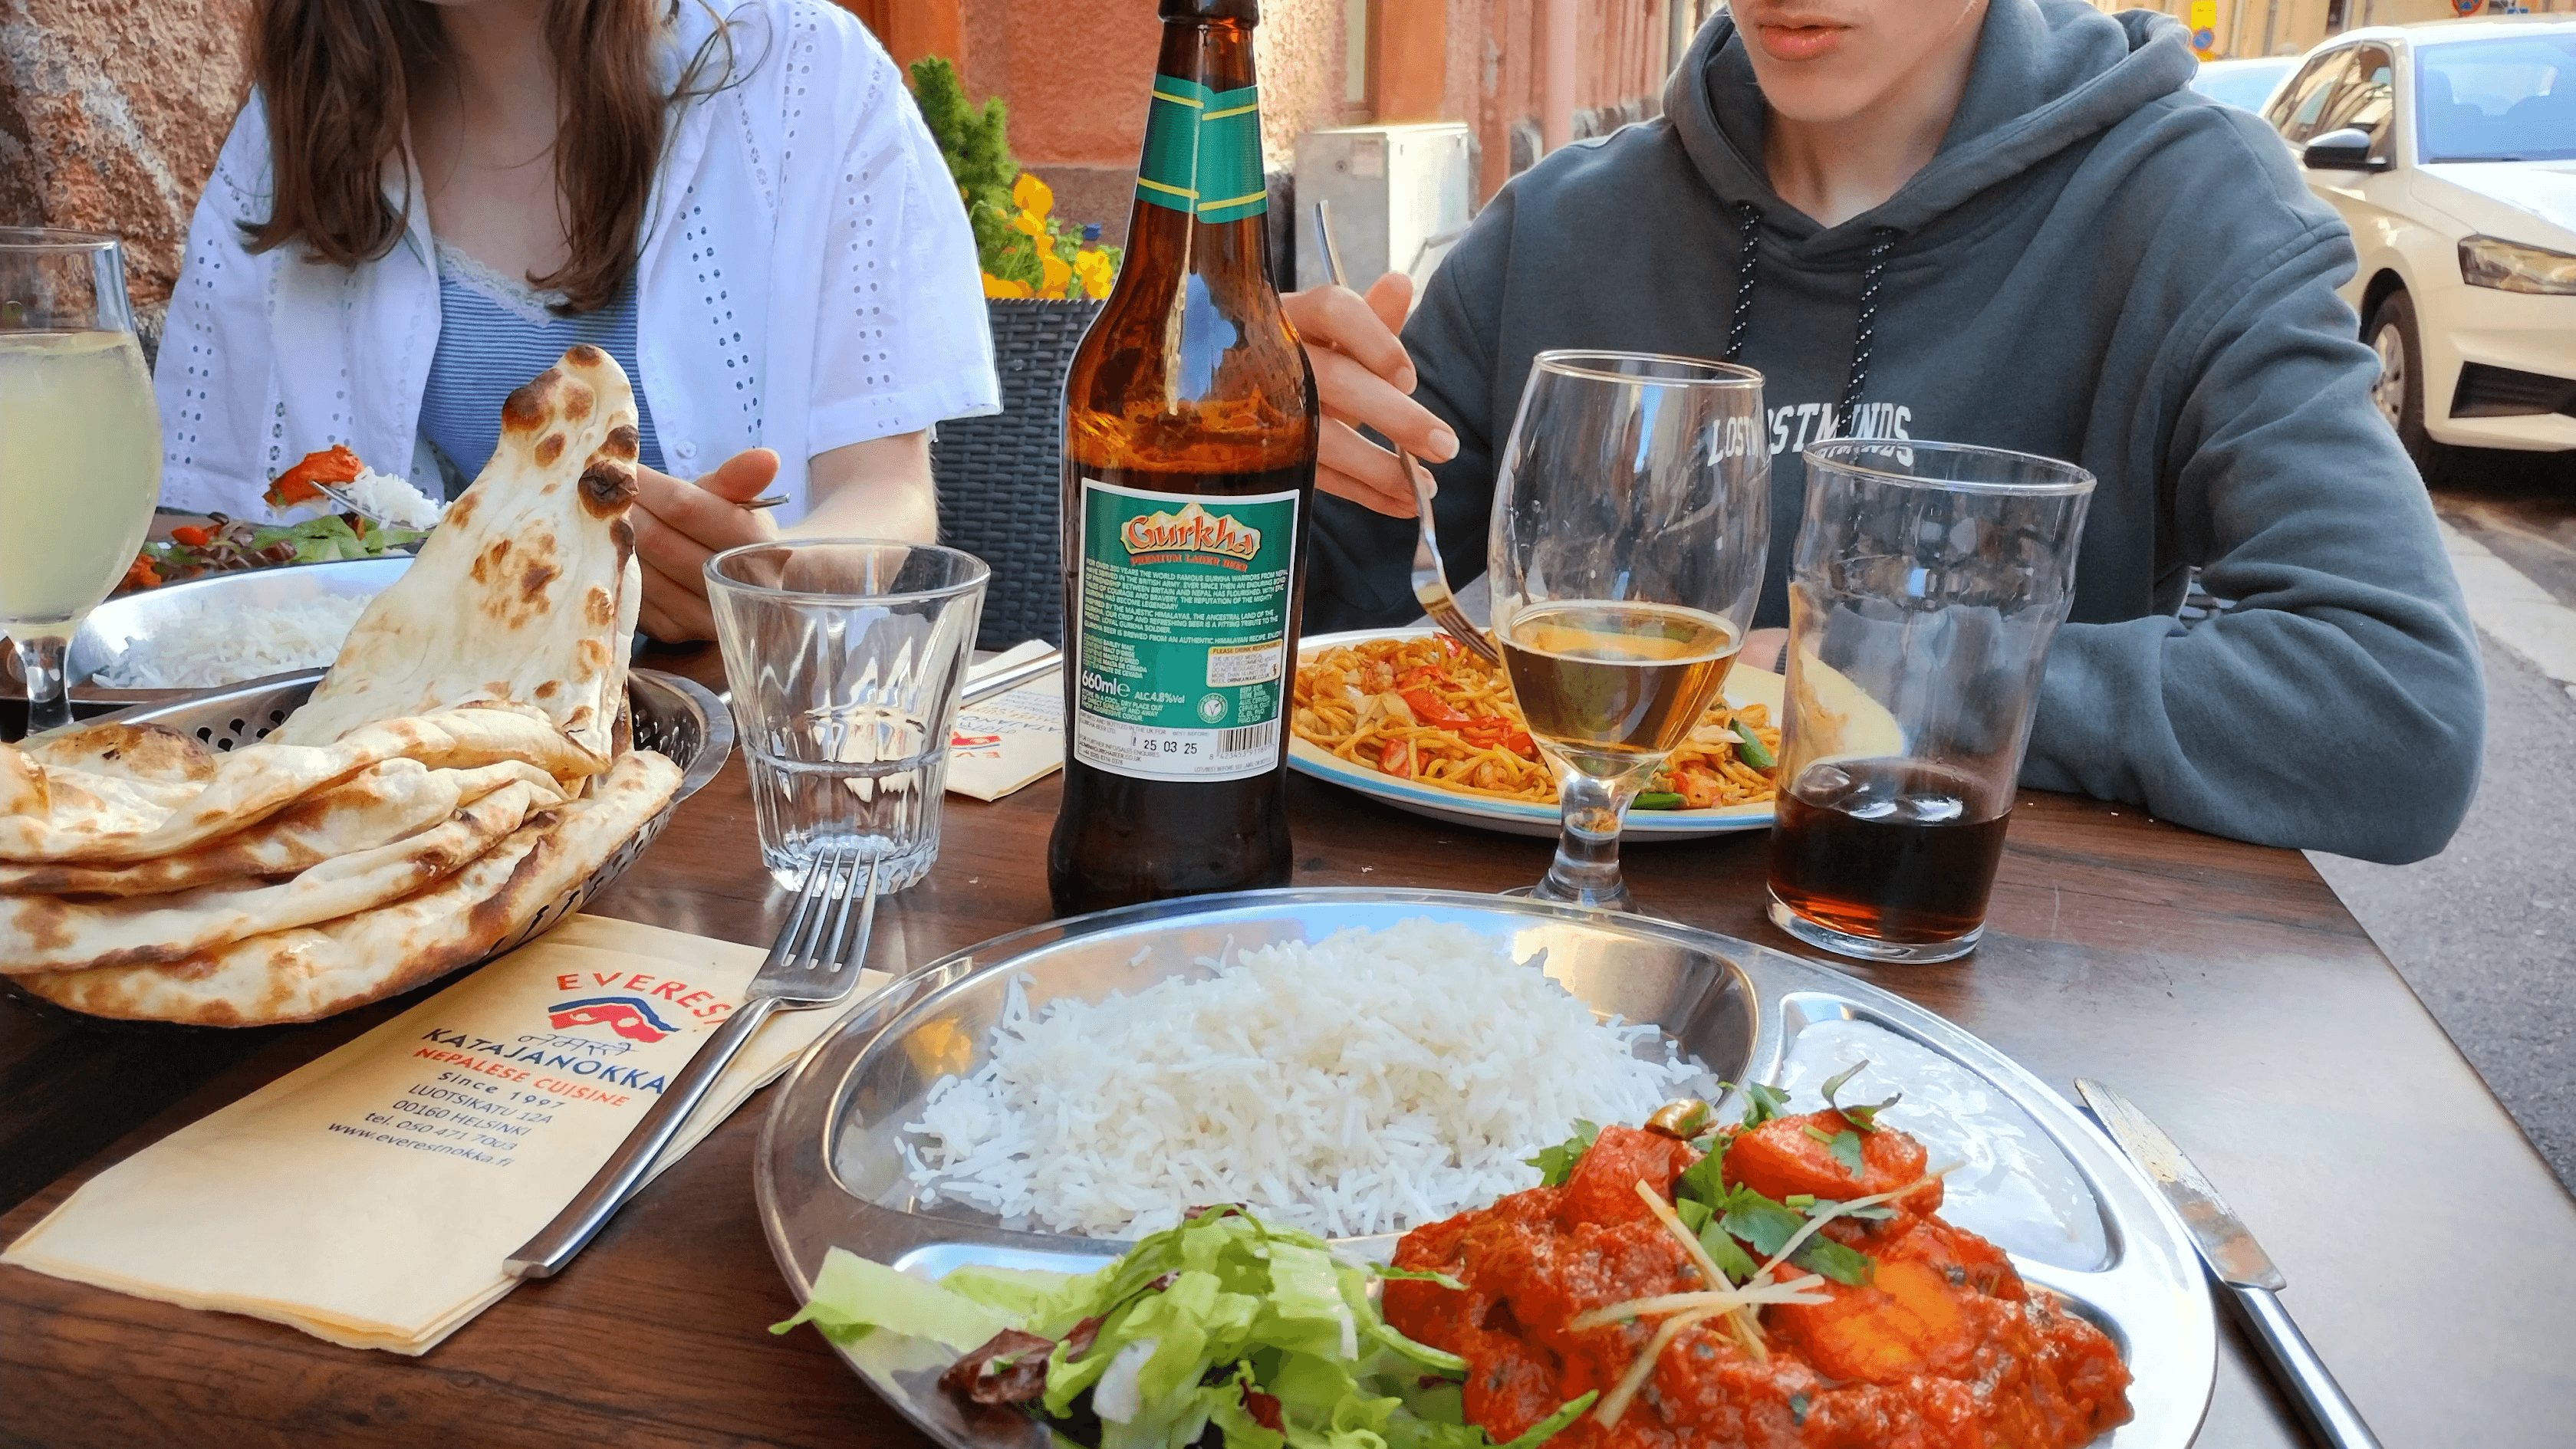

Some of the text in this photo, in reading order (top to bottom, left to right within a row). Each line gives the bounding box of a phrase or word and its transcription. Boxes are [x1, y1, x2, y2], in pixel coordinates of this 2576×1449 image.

[1129, 516, 1253, 555] Gurkha
[1130, 554, 1248, 572] PREMIUM LAGER BEER
[1120, 567, 1139, 576] YEARS
[1152, 571, 1176, 580] WORLD
[1176, 573, 1204, 581] FAMOUS
[1122, 582, 1150, 593] BETWEEN
[1150, 586, 1175, 595] BRITAIN
[1126, 575, 1138, 583] THE
[1139, 577, 1161, 586] BRITISH
[1246, 579, 1273, 588] ENDURING
[1104, 593, 1115, 602] HAS
[1116, 596, 1141, 606] BECOME
[1135, 591, 1149, 600] AND
[1253, 594, 1273, 603] MIGHTY
[1125, 606, 1153, 616] MAJESTIC
[1241, 612, 1257, 620] LAND
[1101, 617, 1118, 626] LOYAL
[1119, 620, 1144, 630] GURKHA
[1134, 616, 1149, 624] AND
[1149, 618, 1187, 627] REFRESHING
[1241, 619, 1262, 627] TRIBUTE
[1124, 630, 1148, 639] BREWED
[1107, 720, 1127, 730] BOTTLED
[1144, 740, 1197, 754] 25 03 25
[1220, 751, 1246, 760] 423453
[421, 1028, 666, 1094] KATAJANOKKA
[413, 1047, 630, 1107] NEPALESE CUISINE
[408, 1083, 554, 1124] LUOTSIKATU 12A
[510, 1091, 567, 1109] 1997
[393, 1100, 533, 1136] 00160 HELSINKI
[364, 1112, 518, 1151] tel. 050 471 7003
[327, 1122, 515, 1168] www.everestnokka.fi
